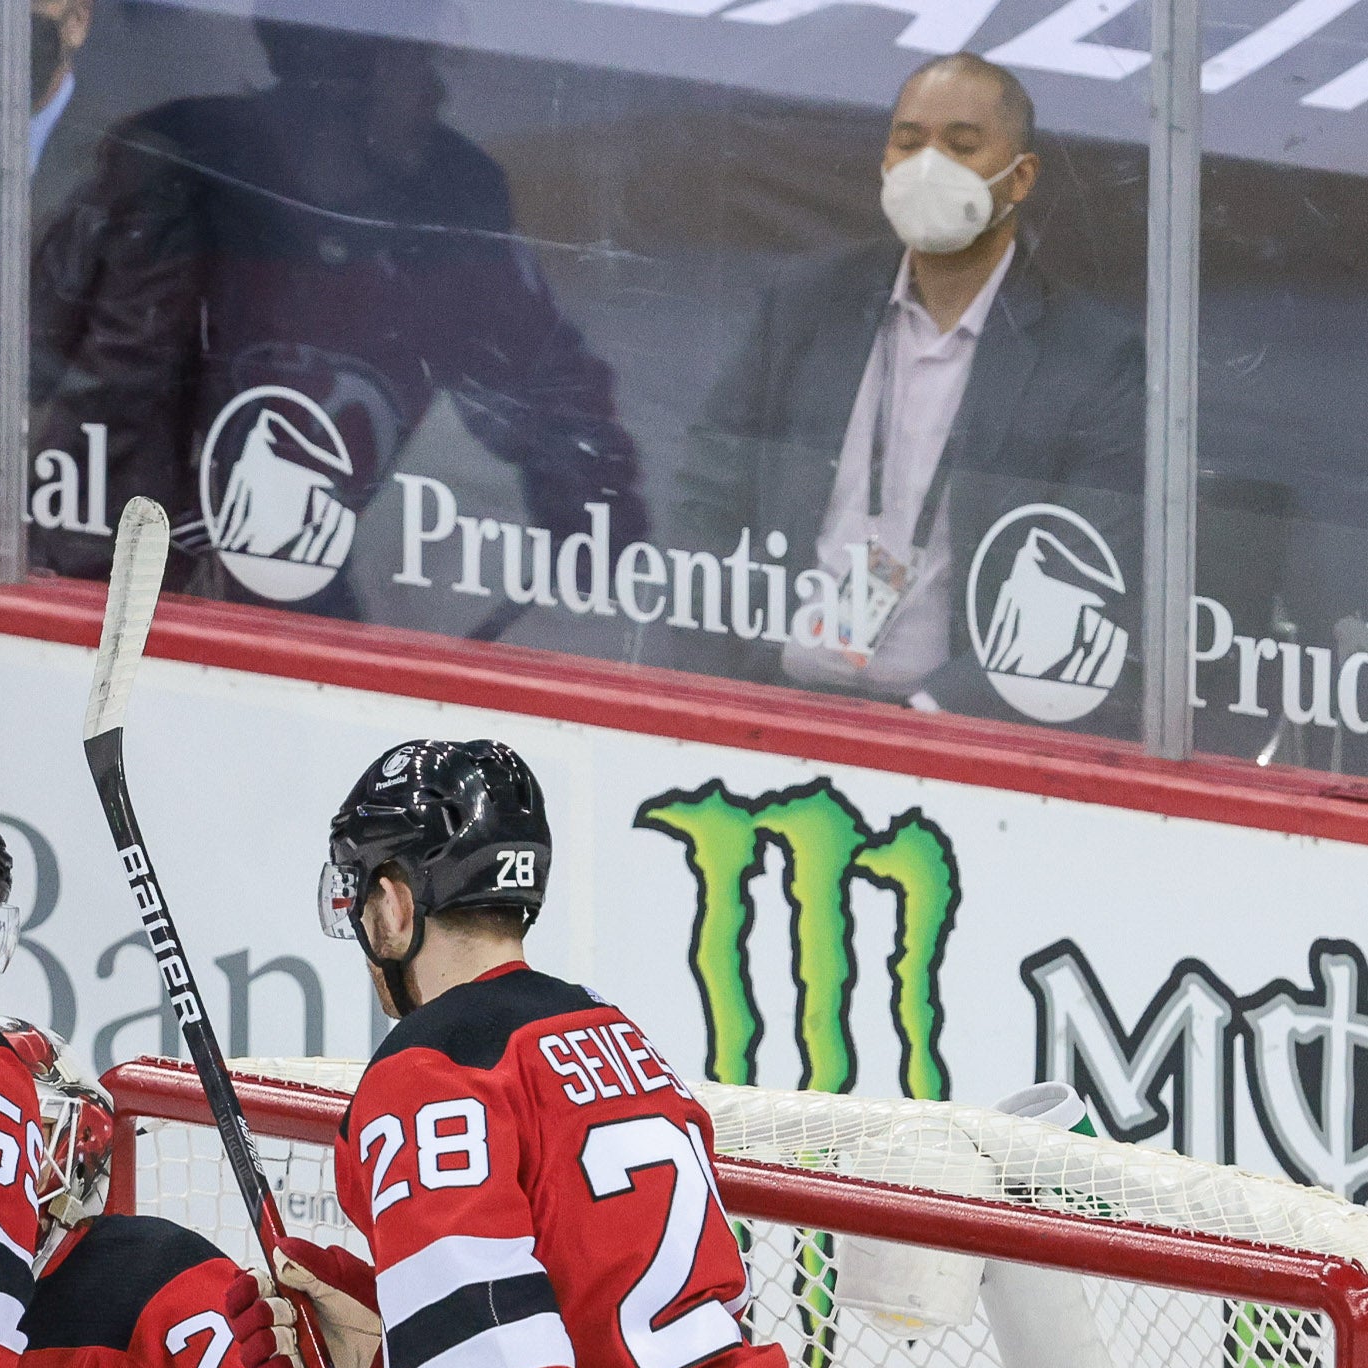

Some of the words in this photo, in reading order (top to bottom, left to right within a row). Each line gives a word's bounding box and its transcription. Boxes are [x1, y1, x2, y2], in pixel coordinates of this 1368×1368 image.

[393, 472, 877, 656] Prudential
[118, 844, 203, 1027] BAUER
[496, 850, 535, 888] 28
[359, 1096, 491, 1220] 28
